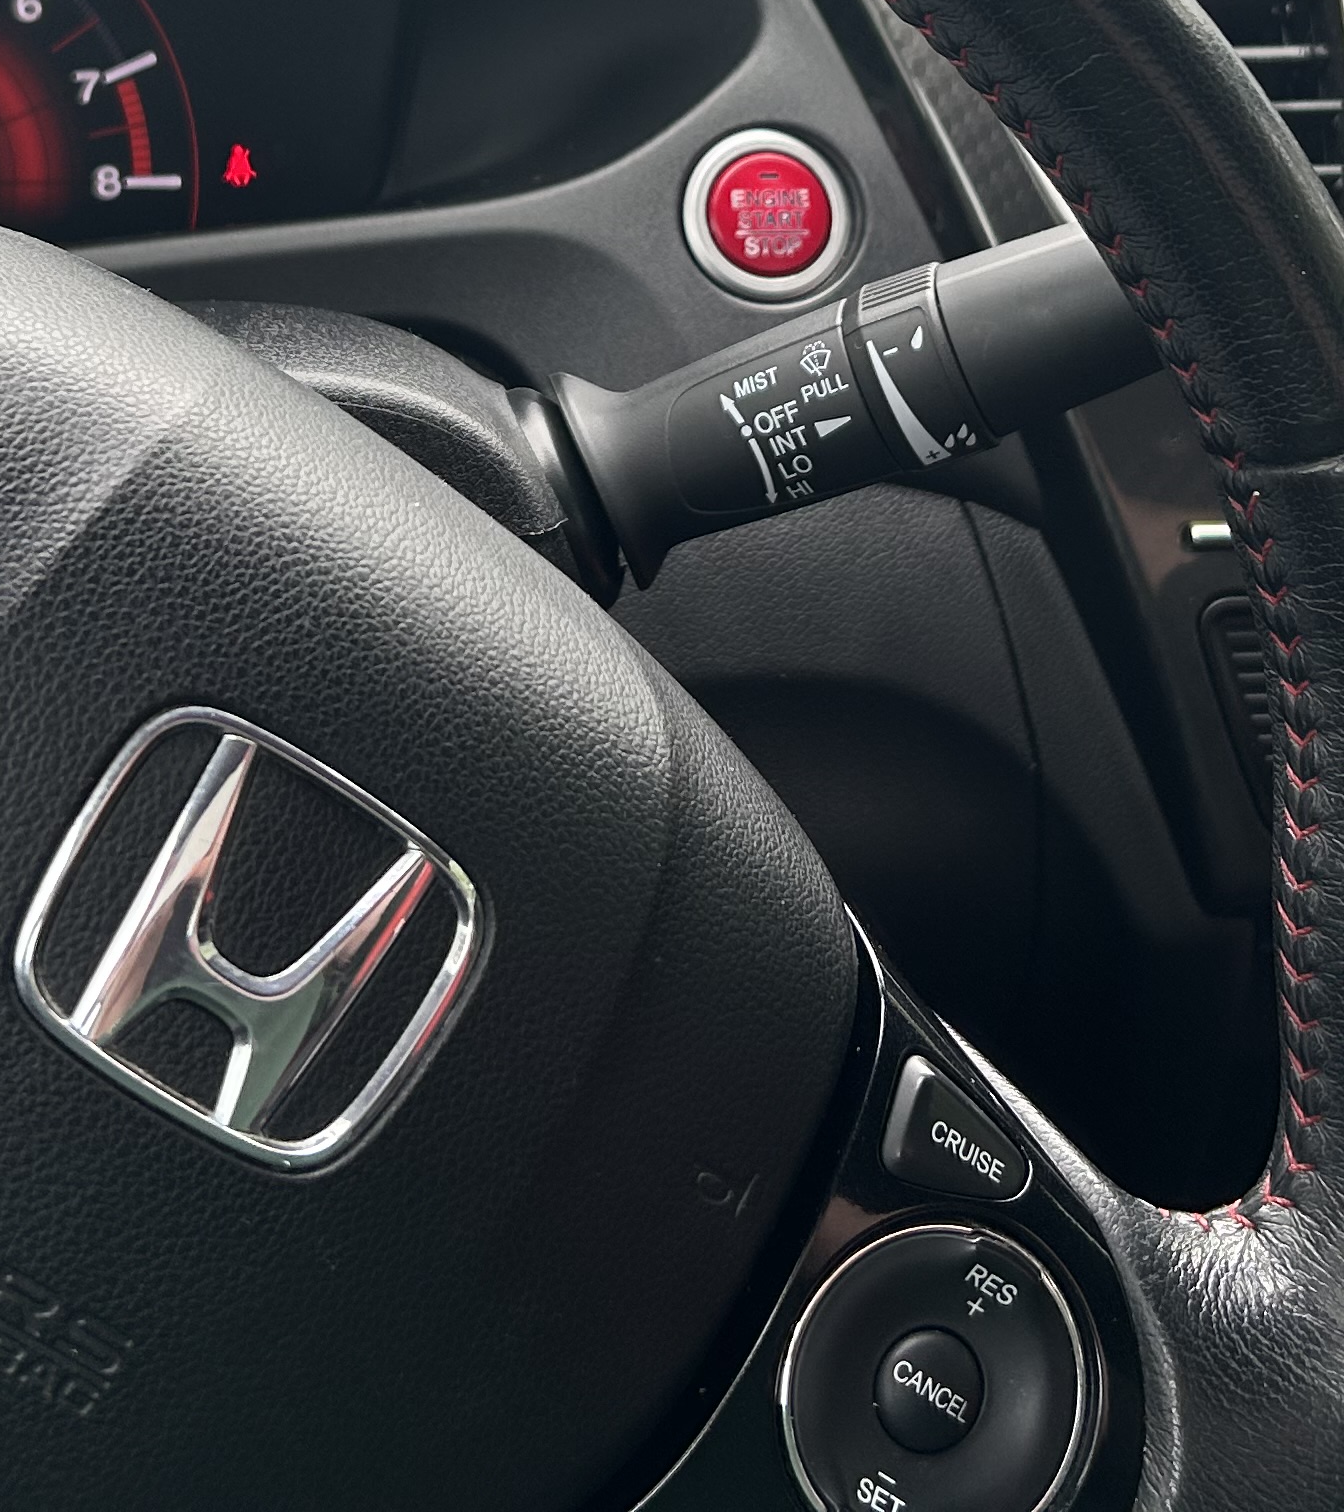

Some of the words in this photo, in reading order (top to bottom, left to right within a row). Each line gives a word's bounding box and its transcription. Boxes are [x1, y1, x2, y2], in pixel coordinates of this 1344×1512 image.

[72, 69, 102, 105] 7
[94, 166, 123, 201] 8
[731, 189, 809, 208] ENGINE
[738, 209, 804, 228] START
[744, 236, 802, 257] STOP
[733, 366, 779, 400] MIST
[800, 373, 850, 405] PULL
[753, 399, 800, 435] OFF
[768, 426, 807, 458] INT
[777, 455, 814, 481] LO
[786, 479, 815, 499] HI
[931, 1120, 1005, 1183] CRUISE
[964, 1262, 1018, 1306] RES
[893, 1359, 968, 1424] CANCEL
[857, 1476, 906, 1512] SET
